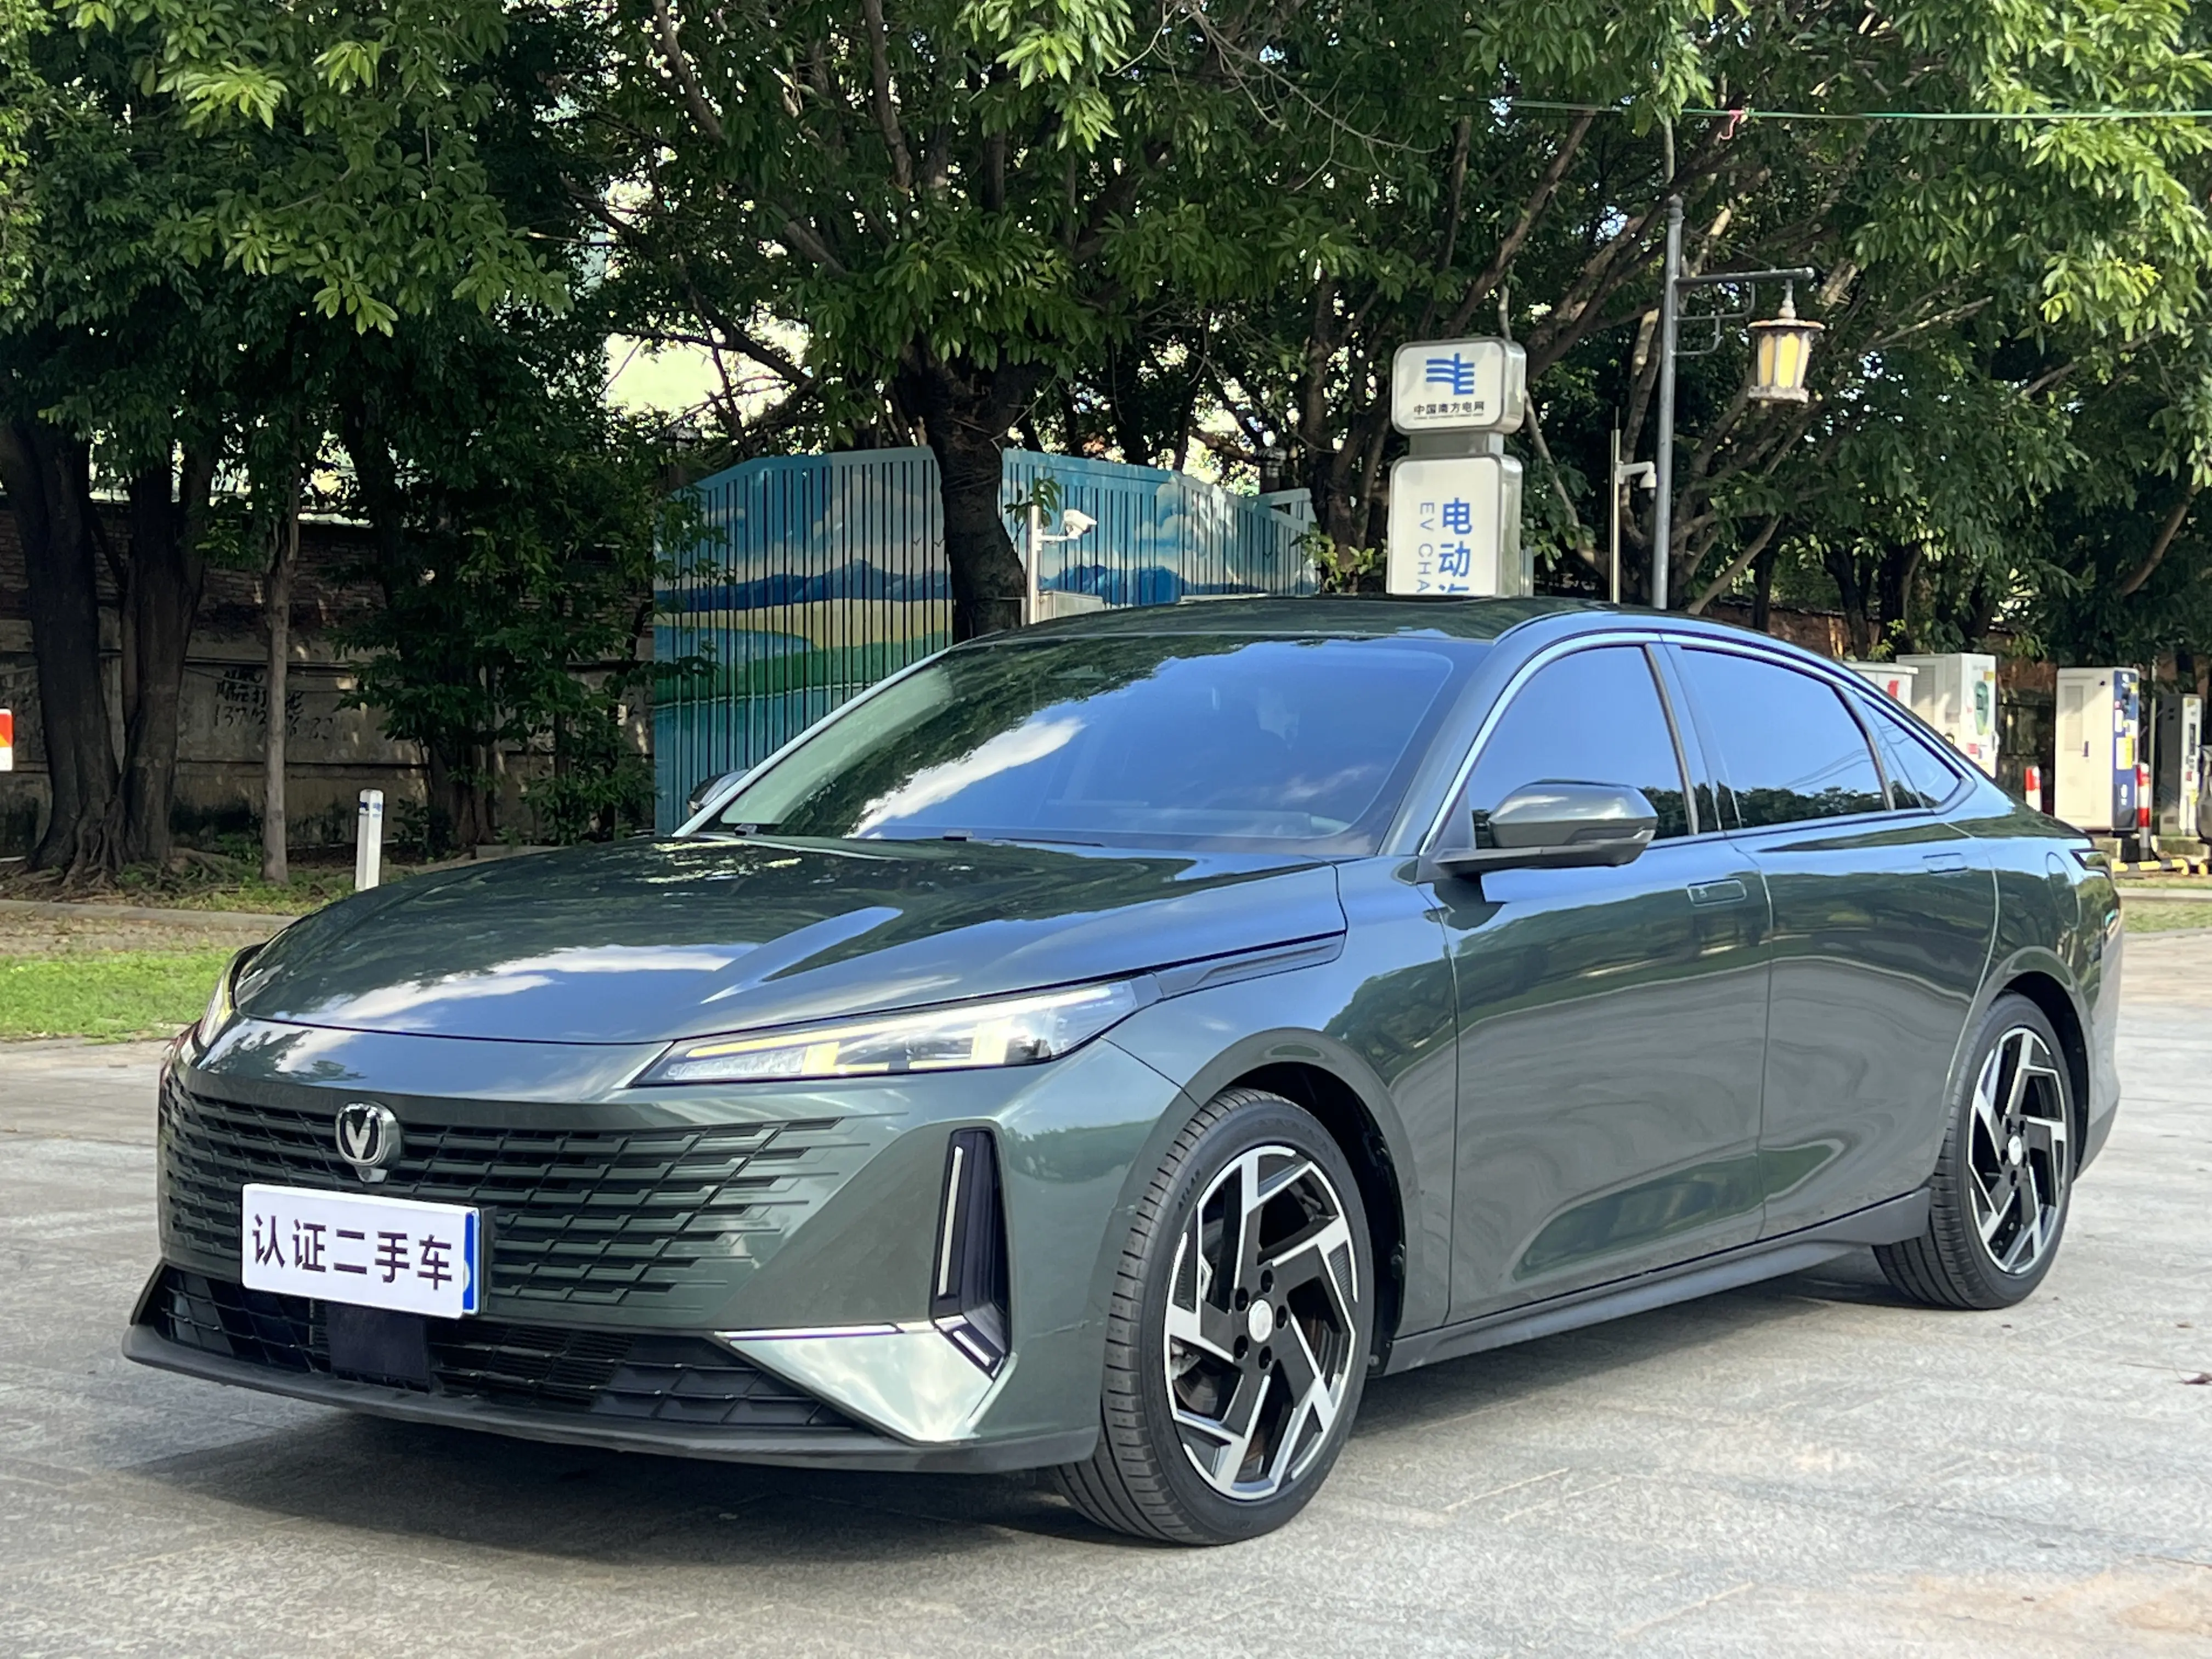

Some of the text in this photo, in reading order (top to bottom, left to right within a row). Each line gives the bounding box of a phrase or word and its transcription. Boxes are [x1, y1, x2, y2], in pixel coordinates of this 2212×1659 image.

[1413, 401, 1485, 415] 中国南方电网
[1420, 501, 1435, 532] EV
[251, 1213, 453, 1291] 认证二手车
